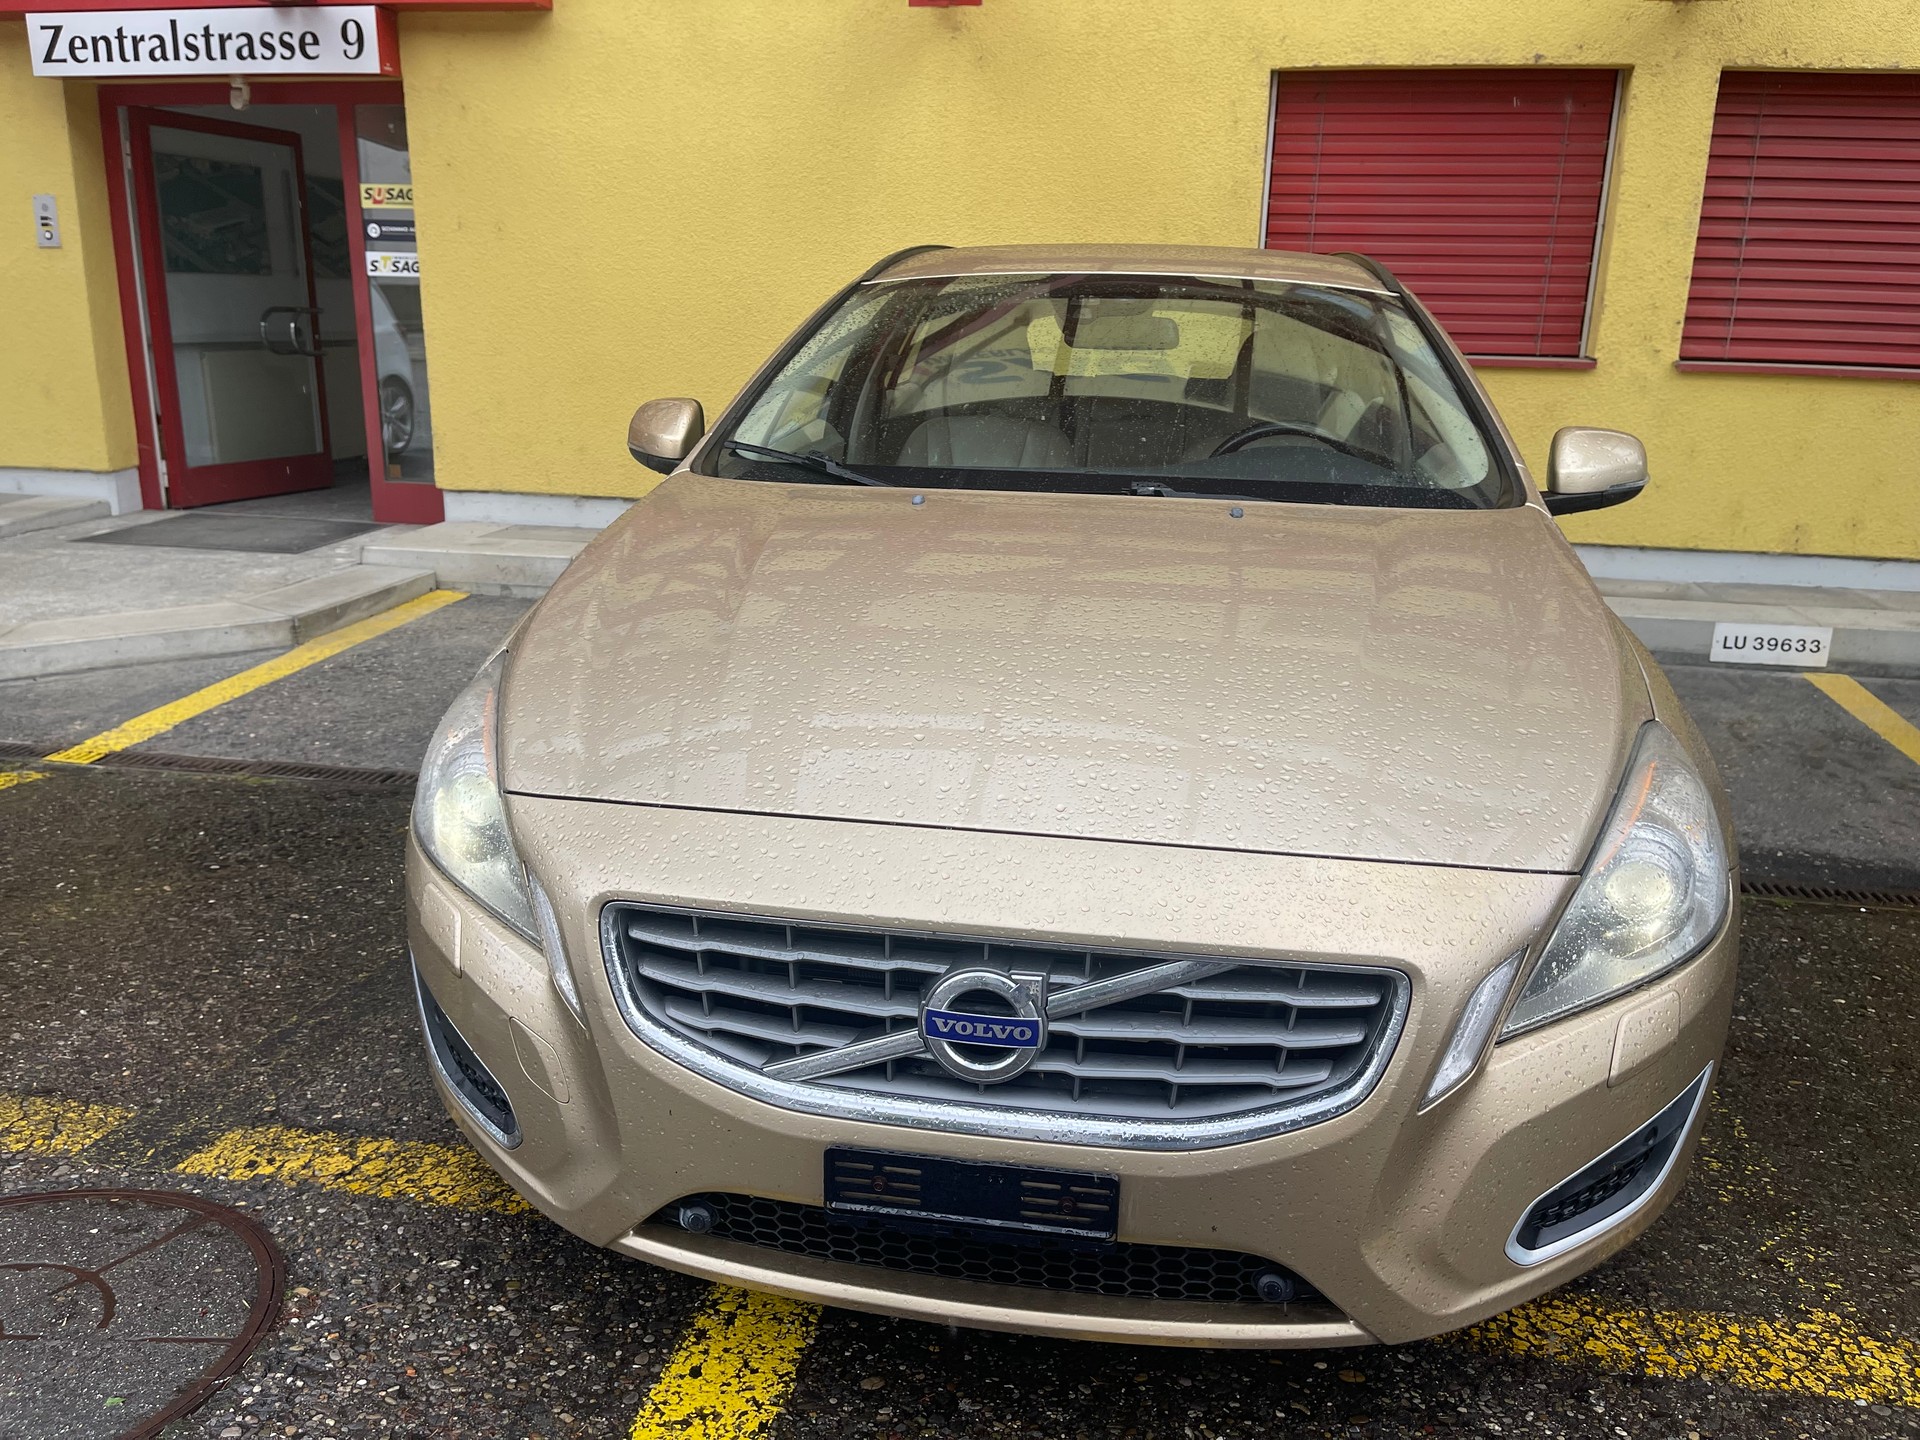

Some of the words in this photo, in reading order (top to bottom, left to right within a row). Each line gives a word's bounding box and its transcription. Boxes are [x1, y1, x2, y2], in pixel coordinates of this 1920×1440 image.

[40, 19, 320, 64] Zentralstrasse
[340, 19, 365, 60] 9
[1722, 635, 1747, 650] LU
[1753, 637, 1821, 653] 39633
[932, 1017, 1032, 1041] VOLVO
